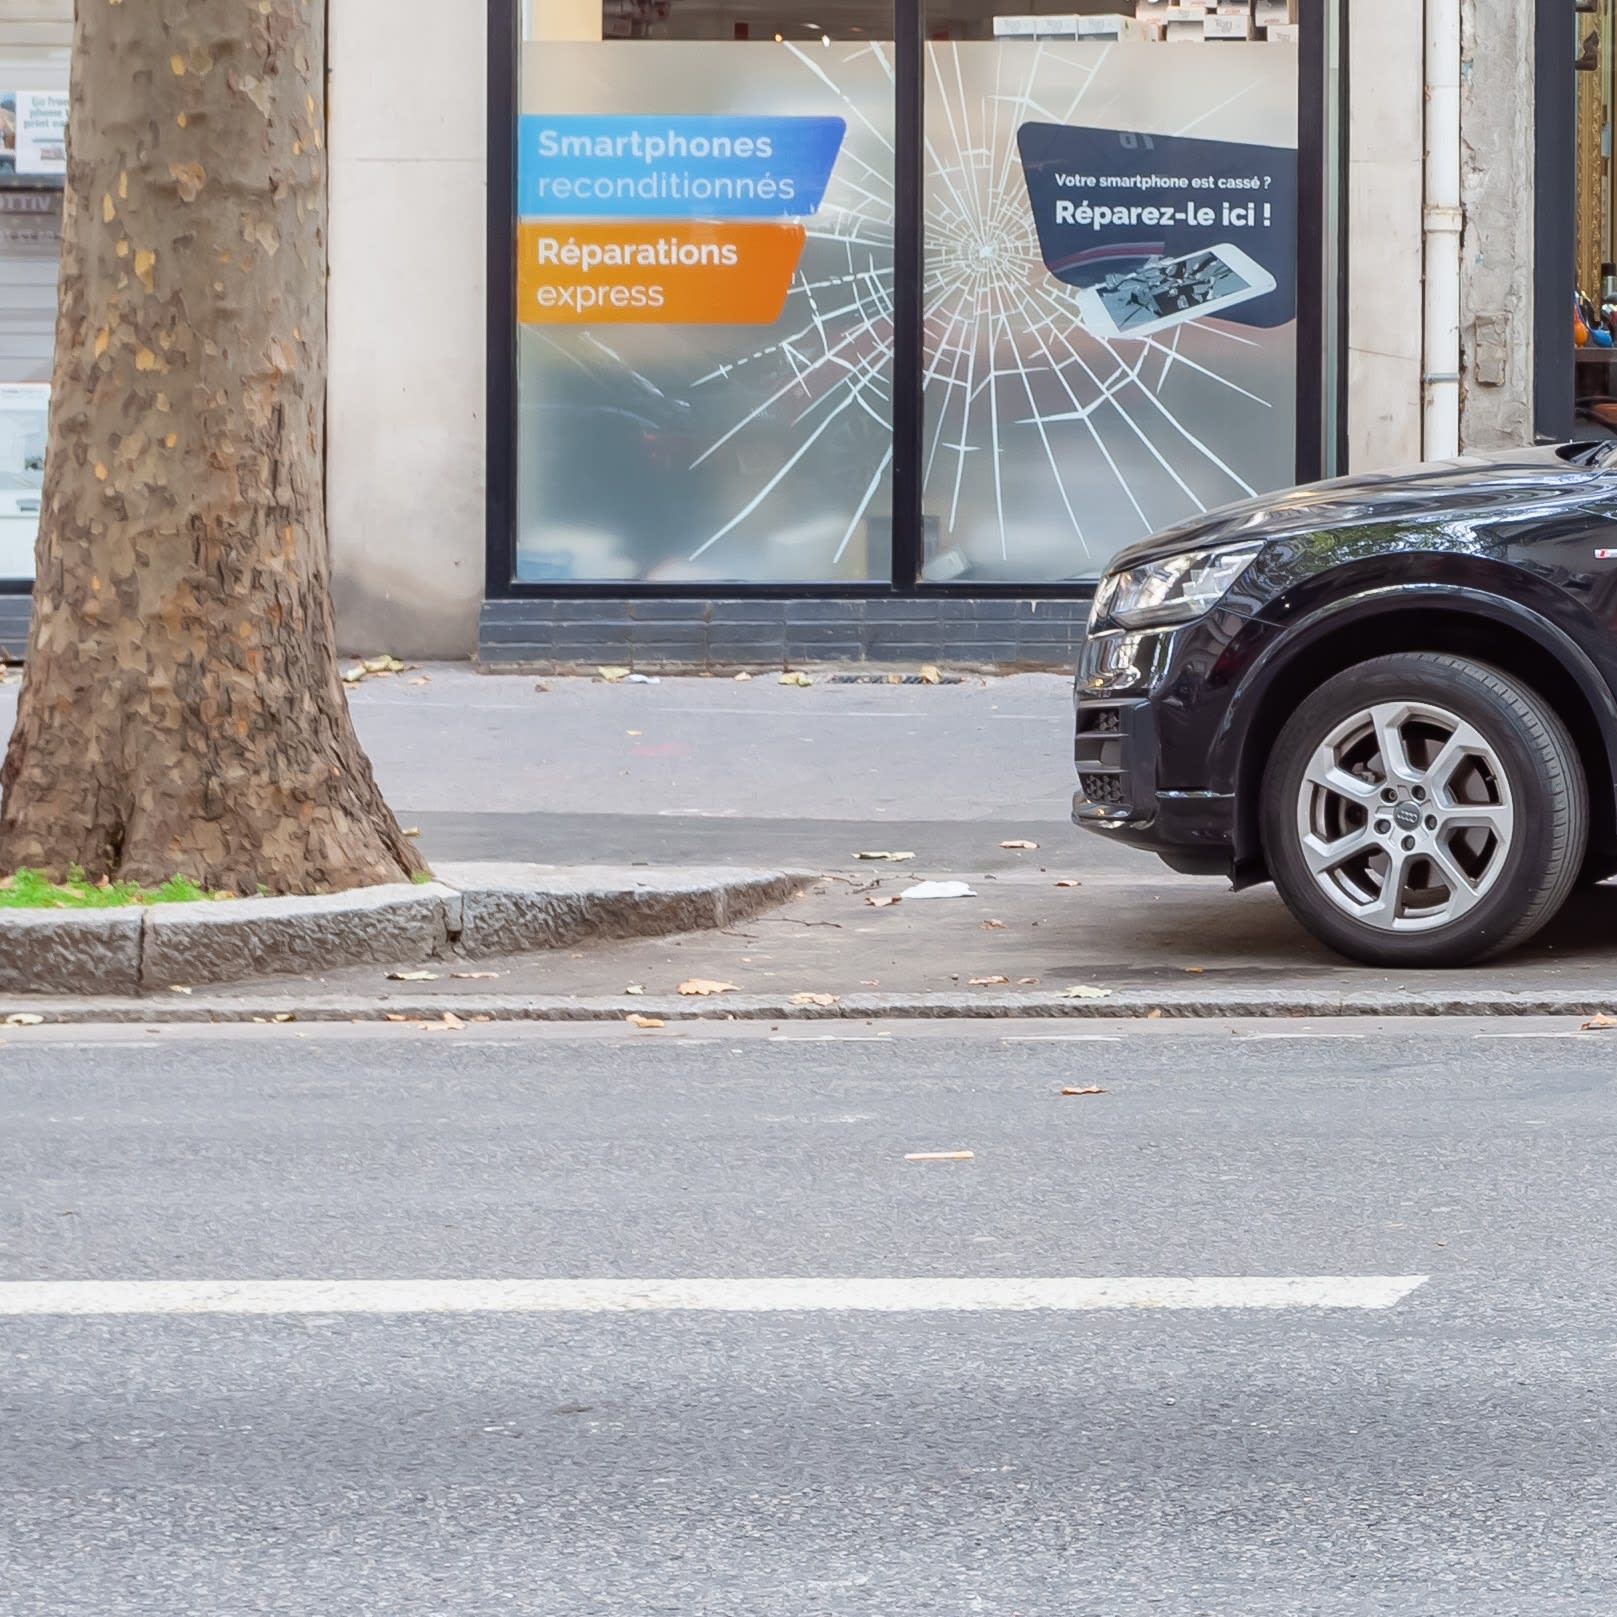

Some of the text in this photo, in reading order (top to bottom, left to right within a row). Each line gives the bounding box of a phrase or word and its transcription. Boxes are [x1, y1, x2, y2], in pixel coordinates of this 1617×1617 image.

[538, 129, 773, 164] Smartphones
[538, 171, 796, 200] reconditionnés
[1055, 173, 1272, 192] Votre smartphone est cassé ?
[1055, 200, 1272, 230] Réparez-le ici !
[537, 237, 738, 272] Réparations
[536, 284, 665, 312] express
